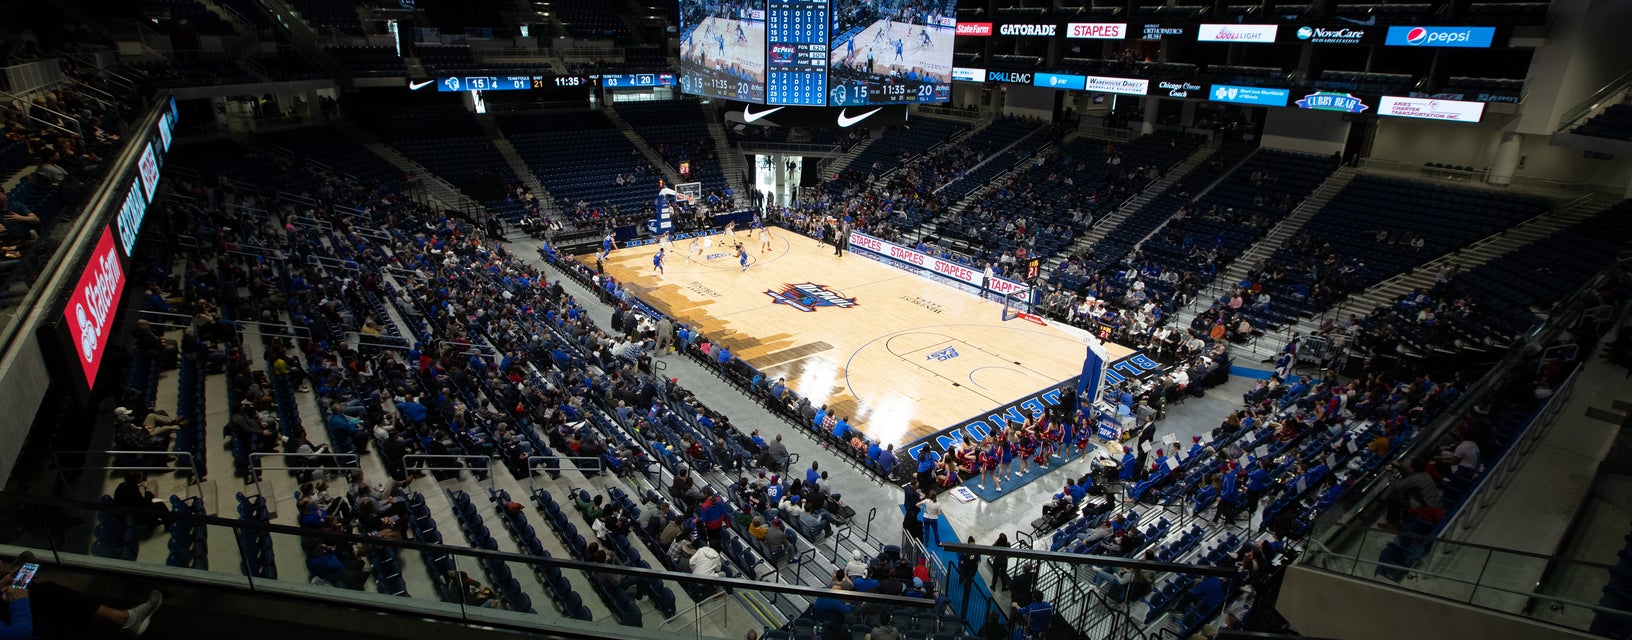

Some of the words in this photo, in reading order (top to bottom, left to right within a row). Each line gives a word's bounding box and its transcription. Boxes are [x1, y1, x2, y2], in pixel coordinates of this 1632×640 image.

[1000, 24, 1057, 36] GATORADE
[1074, 25, 1119, 36] STAPLES
[1216, 29, 1239, 39] Coors
[1312, 28, 1364, 38] NovaCare
[1427, 30, 1471, 43] pepsi
[472, 79, 484, 88] 15
[555, 77, 579, 86] 11:35
[694, 77, 703, 88] 15
[711, 79, 728, 89] 11:35
[1090, 78, 1121, 86] WAREHOUSE
[1159, 81, 1182, 90] Chicago
[737, 82, 749, 94] 20
[854, 86, 868, 98] 15
[883, 85, 905, 94] 11:35
[919, 85, 933, 96] 20
[1307, 96, 1333, 106] CUBBY
[1334, 97, 1356, 109] BEAR
[1392, 110, 1445, 118] TRANSPORTATION
[851, 234, 882, 252] STAPLES
[891, 246, 924, 266] STAPLES
[934, 261, 973, 282] STAPLES
[990, 278, 1027, 300] TAPLES
[1027, 267, 1038, 279] 21
[926, 348, 955, 360] EAST
[937, 352, 959, 362] BIG
